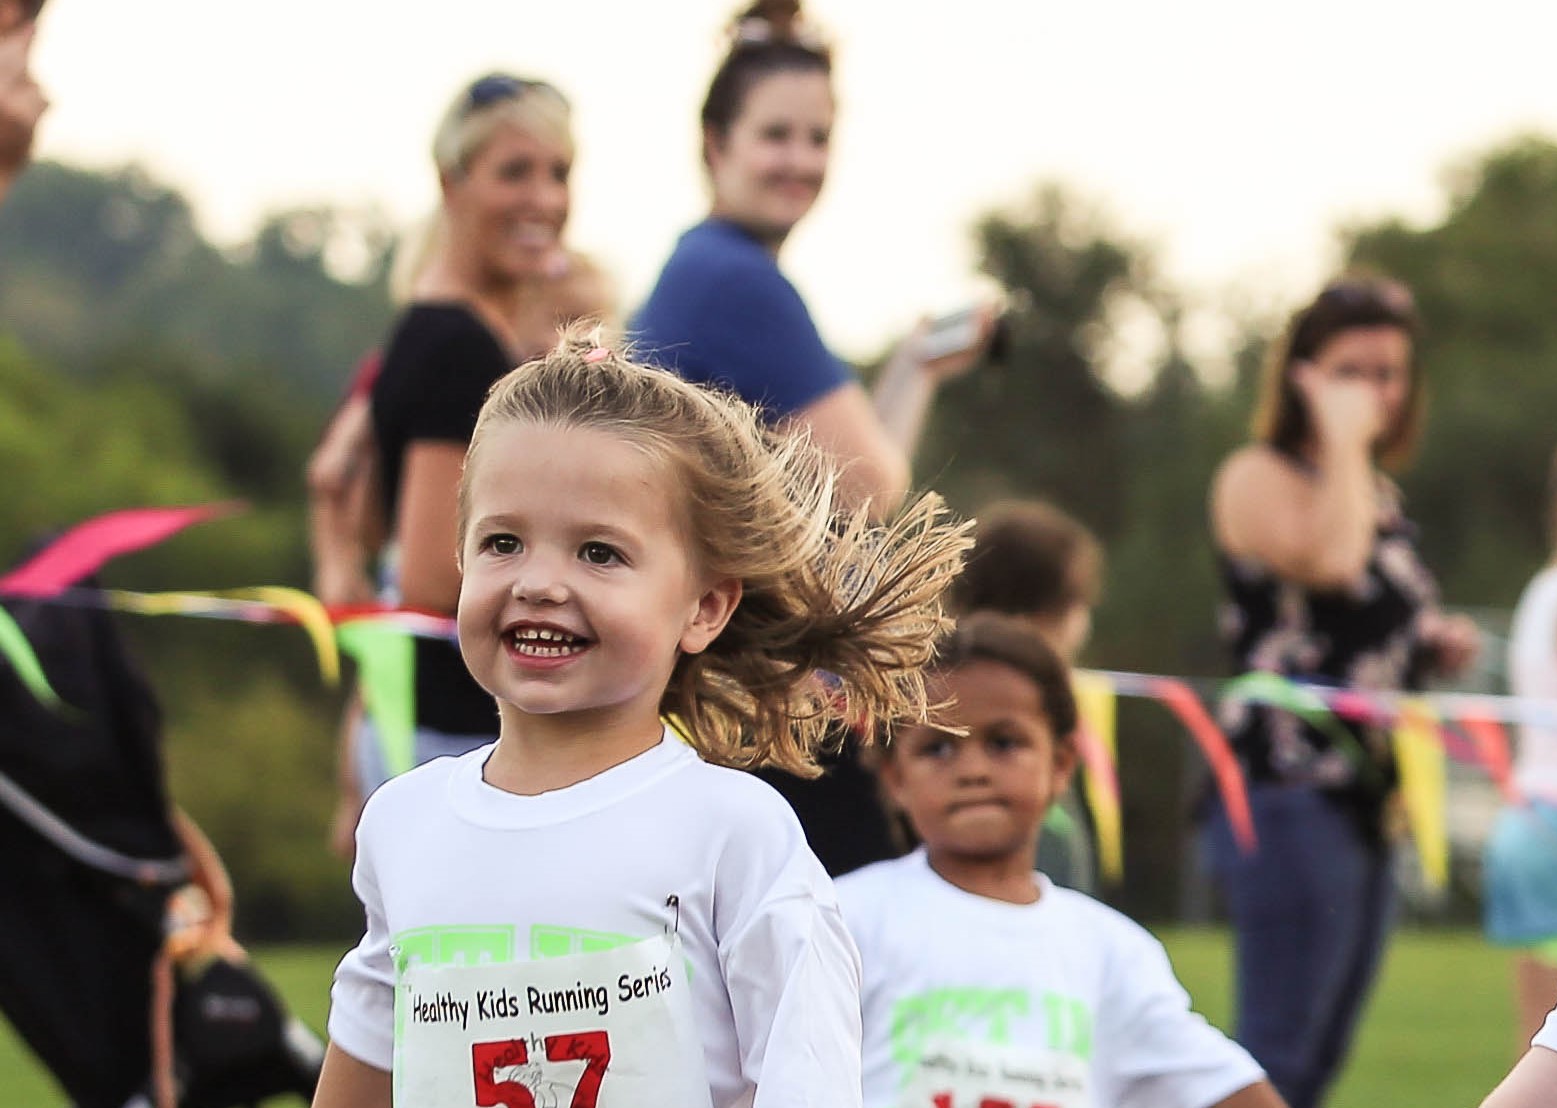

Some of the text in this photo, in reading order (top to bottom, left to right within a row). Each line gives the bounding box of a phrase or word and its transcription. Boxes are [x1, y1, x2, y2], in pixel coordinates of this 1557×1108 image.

[413, 992, 468, 1030] Healthy
[476, 988, 519, 1020] Kids
[527, 981, 608, 1015] Running
